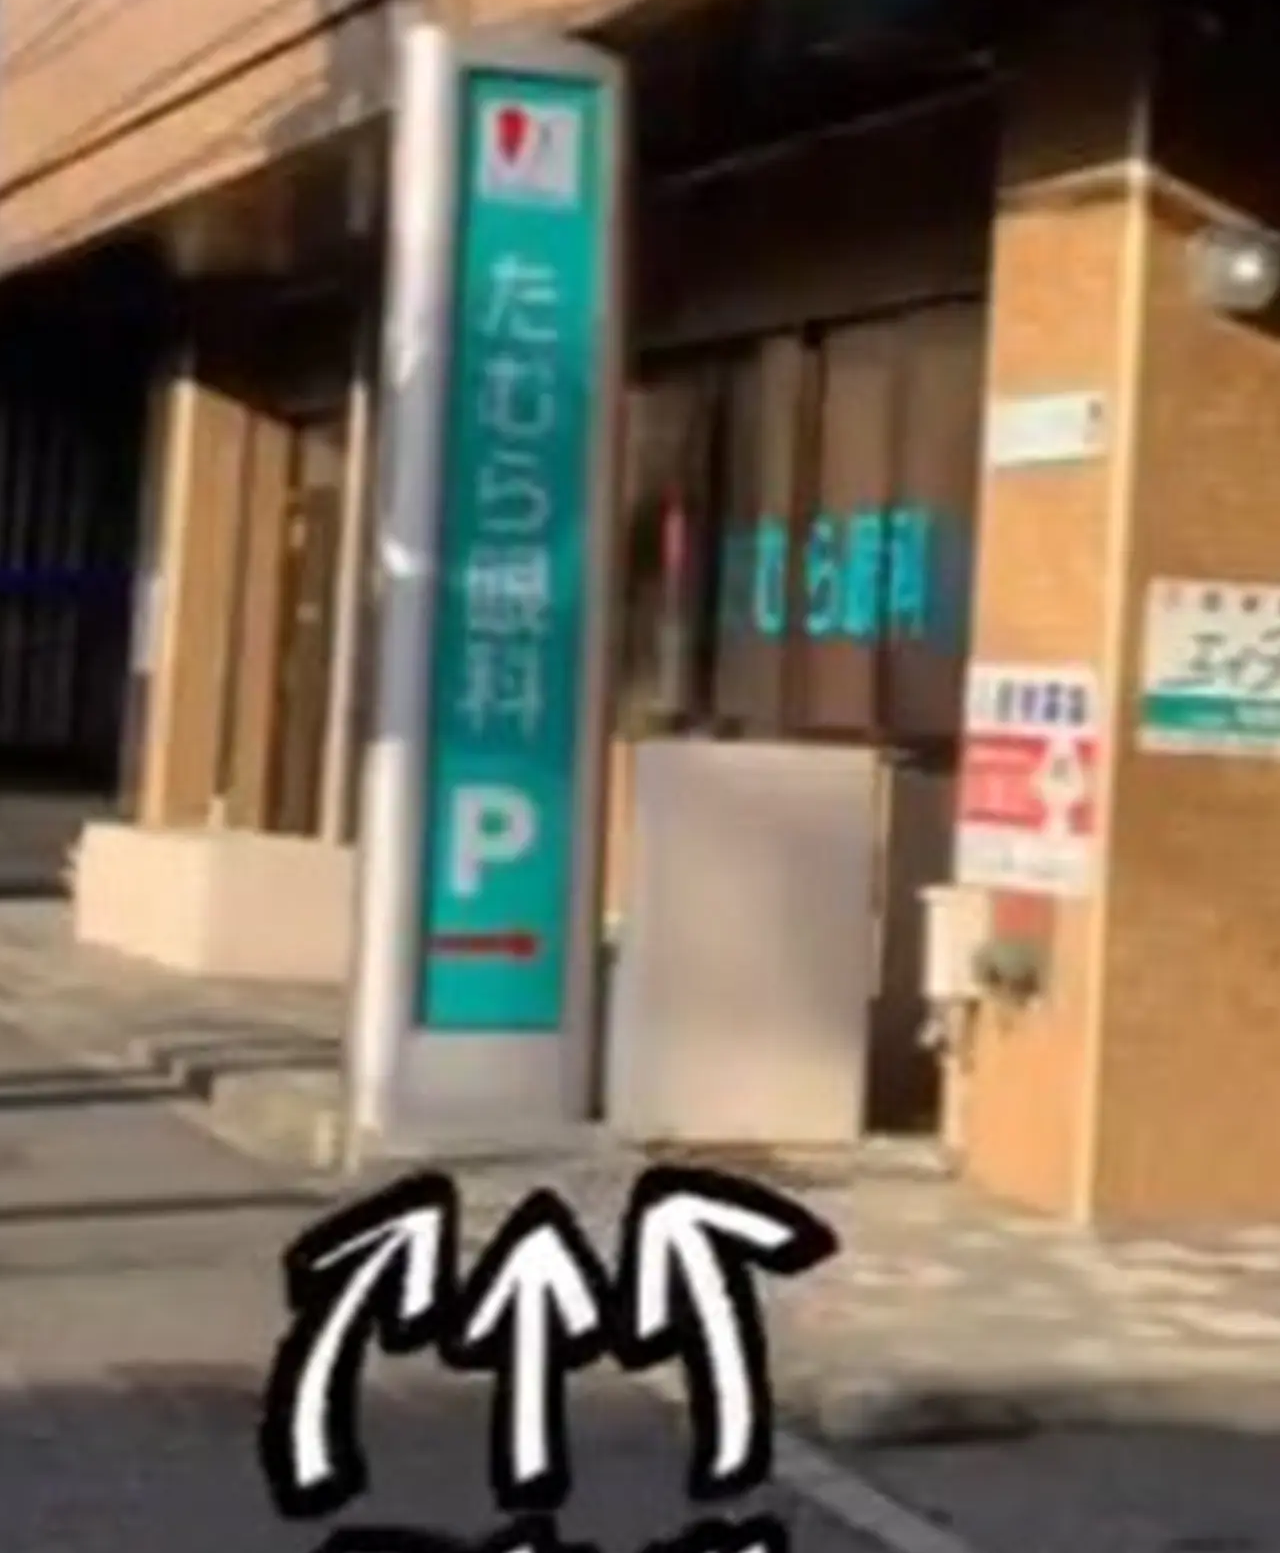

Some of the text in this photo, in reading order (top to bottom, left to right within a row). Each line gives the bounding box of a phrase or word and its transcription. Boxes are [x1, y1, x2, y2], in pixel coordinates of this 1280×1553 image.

[456, 253, 560, 739] たむら眼科
[447, 781, 542, 896] P
